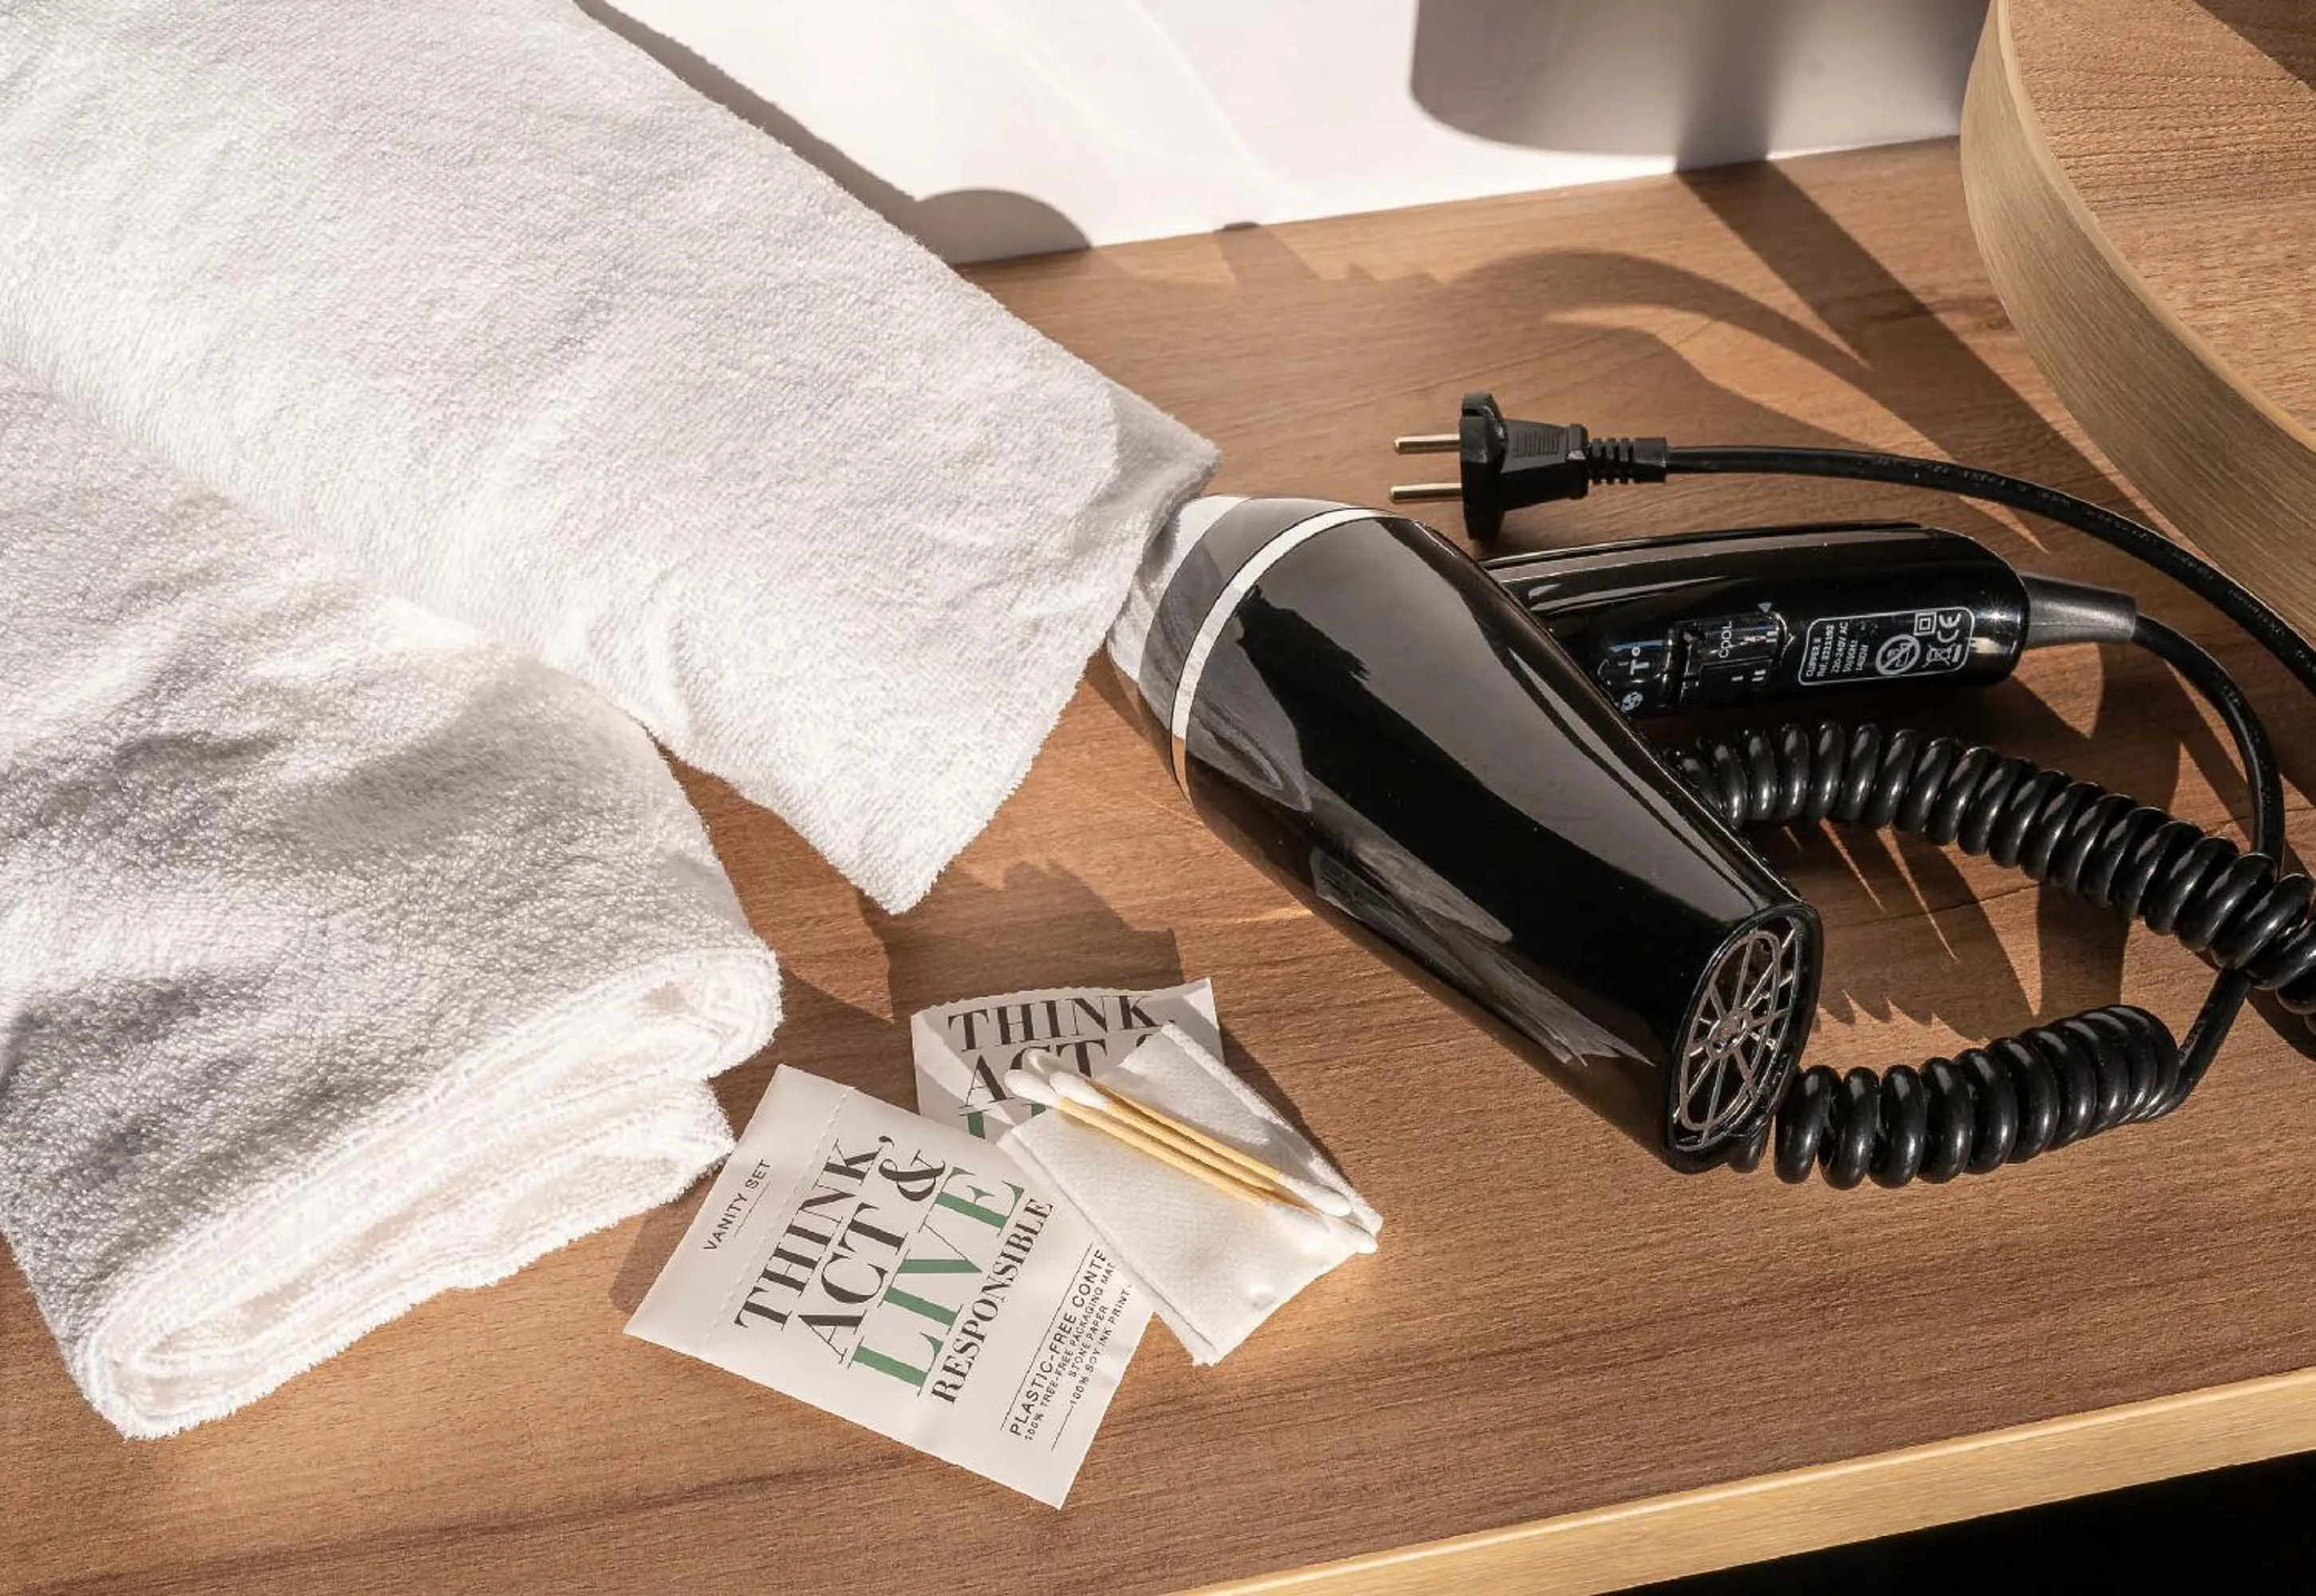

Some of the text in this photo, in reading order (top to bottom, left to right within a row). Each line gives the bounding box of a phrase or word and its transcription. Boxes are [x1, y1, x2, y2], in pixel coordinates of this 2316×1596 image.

[1719, 620, 1732, 659] COOL
[1839, 621, 1849, 636] AC
[947, 995, 1176, 1053] THINK
[704, 1158, 771, 1251] VANITY SET
[733, 1135, 894, 1332] THINK,
[798, 1149, 946, 1364] ACT &
[847, 1166, 1025, 1397] LIVE
[931, 1198, 1054, 1404] RESPONSIBLE
[1068, 1305, 1108, 1378] STONE PAPER
[1009, 1313, 1077, 1436] PLASTIC-FREE
[1025, 1412, 1045, 1441] 100%
[1040, 1348, 1074, 1408] TREE-FREE
[1069, 1286, 1104, 1347] PACKAGING
[1069, 1288, 1132, 1406] 100% SOY INK PRINT
